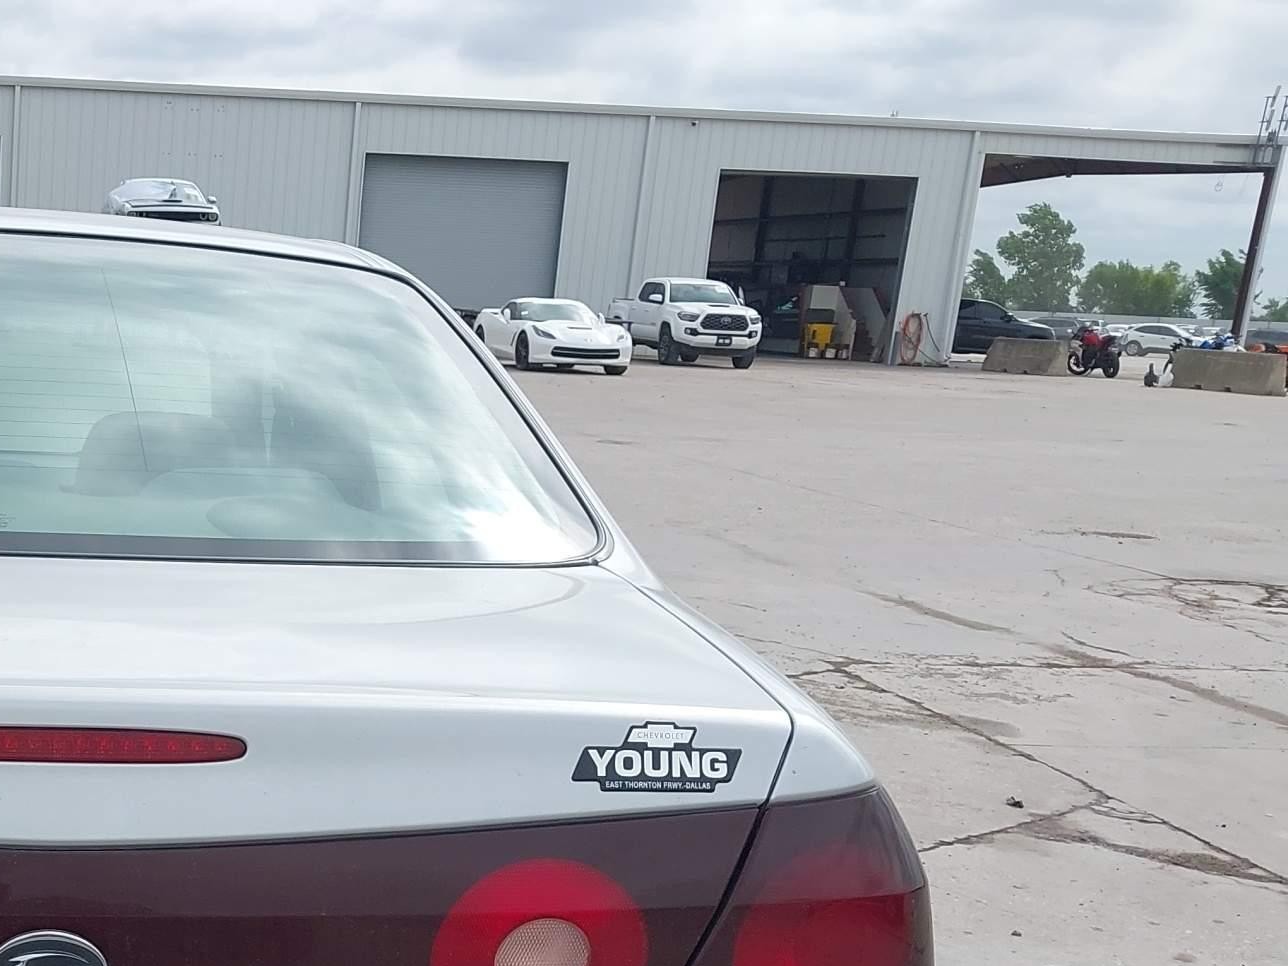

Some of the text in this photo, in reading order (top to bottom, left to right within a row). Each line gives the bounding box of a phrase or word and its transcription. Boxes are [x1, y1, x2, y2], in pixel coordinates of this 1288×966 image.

[636, 731, 684, 740] CHEVROLET
[587, 749, 728, 779] YOUNG
[605, 780, 623, 789] EAST
[625, 781, 662, 789] THORNTON
